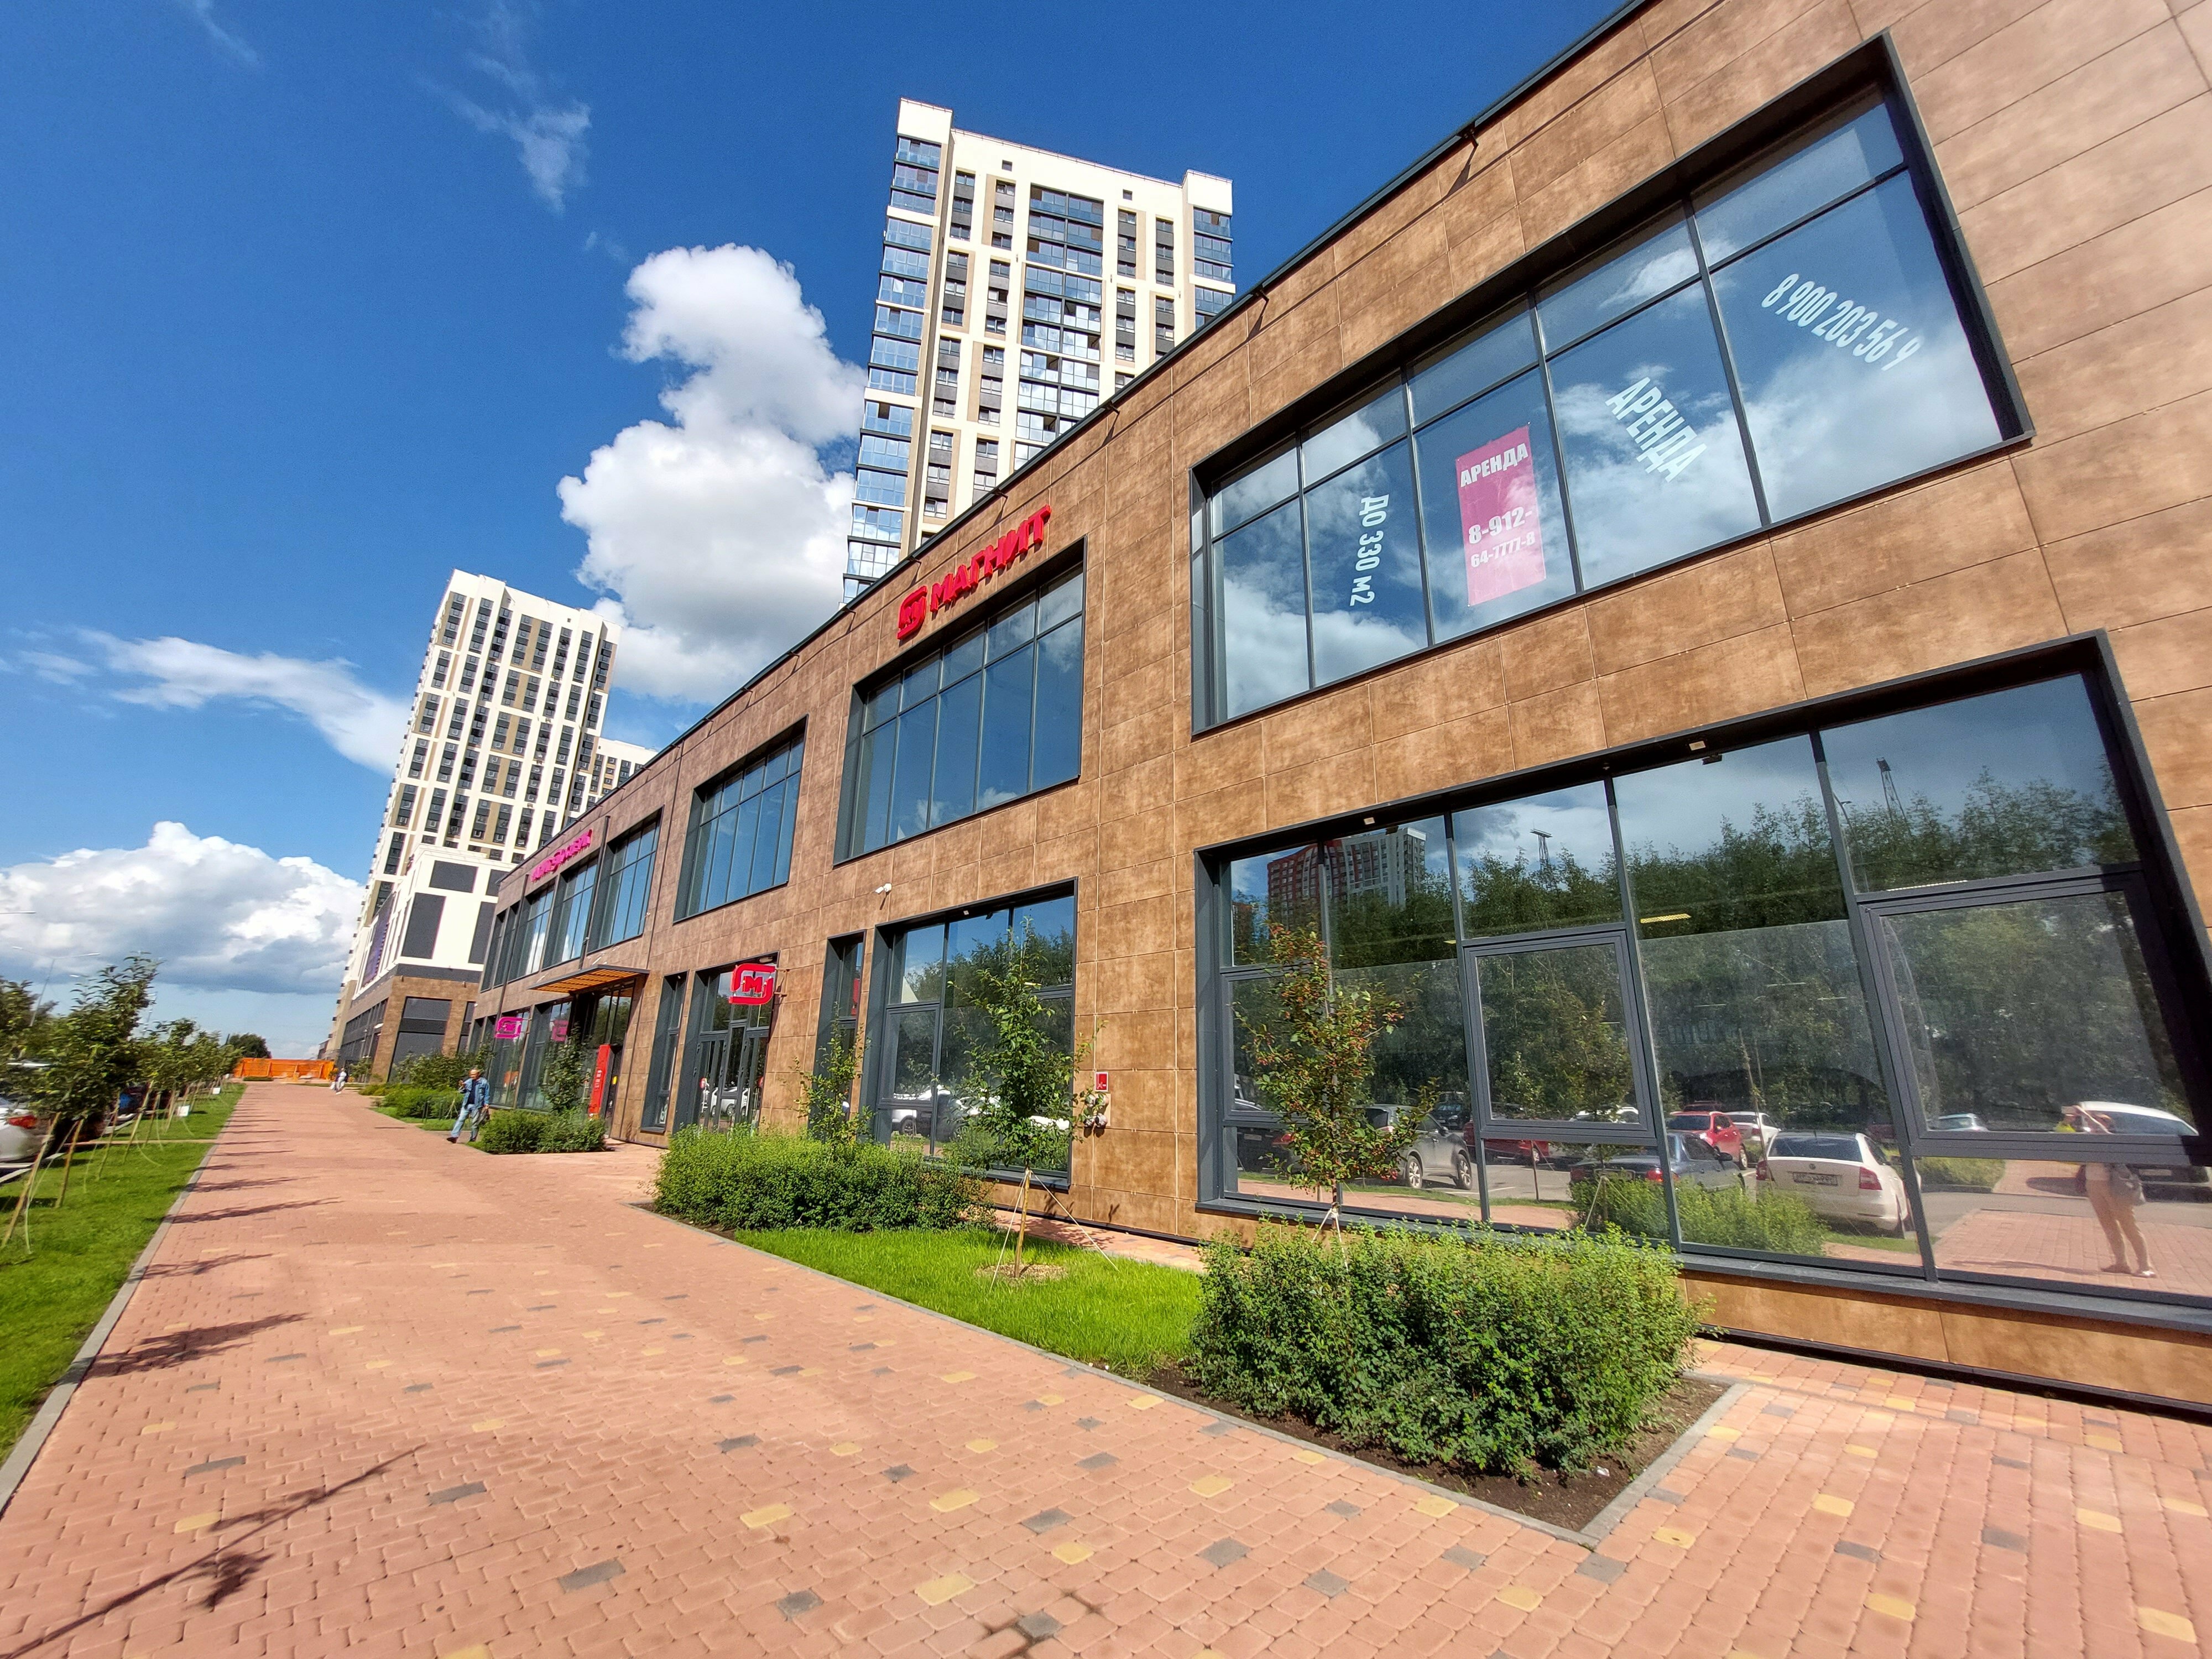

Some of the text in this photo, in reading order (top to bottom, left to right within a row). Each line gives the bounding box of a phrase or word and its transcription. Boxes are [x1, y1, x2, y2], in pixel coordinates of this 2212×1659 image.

[1761, 274, 1799, 307] 8
[1775, 281, 1838, 327] 900
[1811, 300, 1879, 347] 203
[1605, 377, 1707, 483] АРЕНДА
[1460, 443, 1528, 487] АРЕНДА
[1359, 494, 1389, 527] ДО
[1468, 507, 1532, 544] 8-912-
[930, 504, 1051, 612] МАГНИТ
[1355, 530, 1384, 571] 330
[1471, 531, 1535, 567] 64-7777-8
